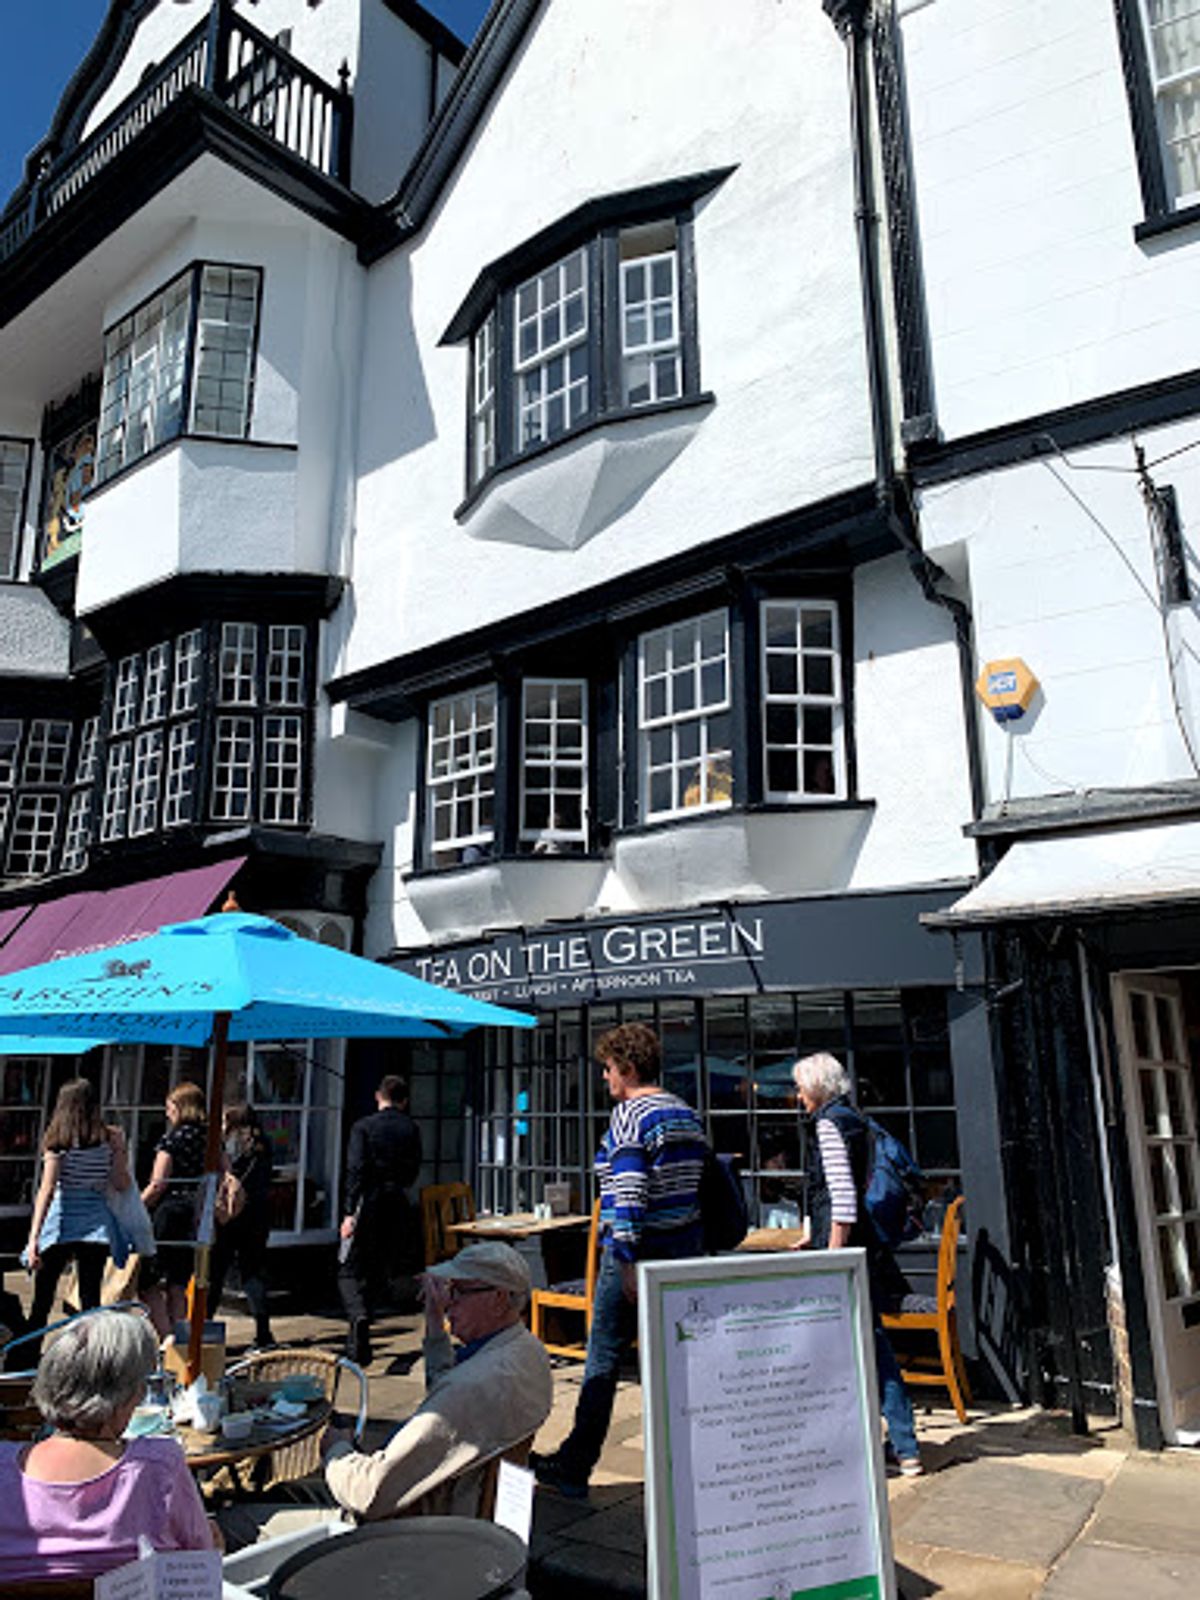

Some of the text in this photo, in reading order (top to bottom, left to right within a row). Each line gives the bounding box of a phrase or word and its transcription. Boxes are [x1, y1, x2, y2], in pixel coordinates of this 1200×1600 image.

[415, 918, 764, 987] TEA ON THE GREEN
[514, 981, 559, 999] LUNCH
[662, 968, 697, 983] TEA
